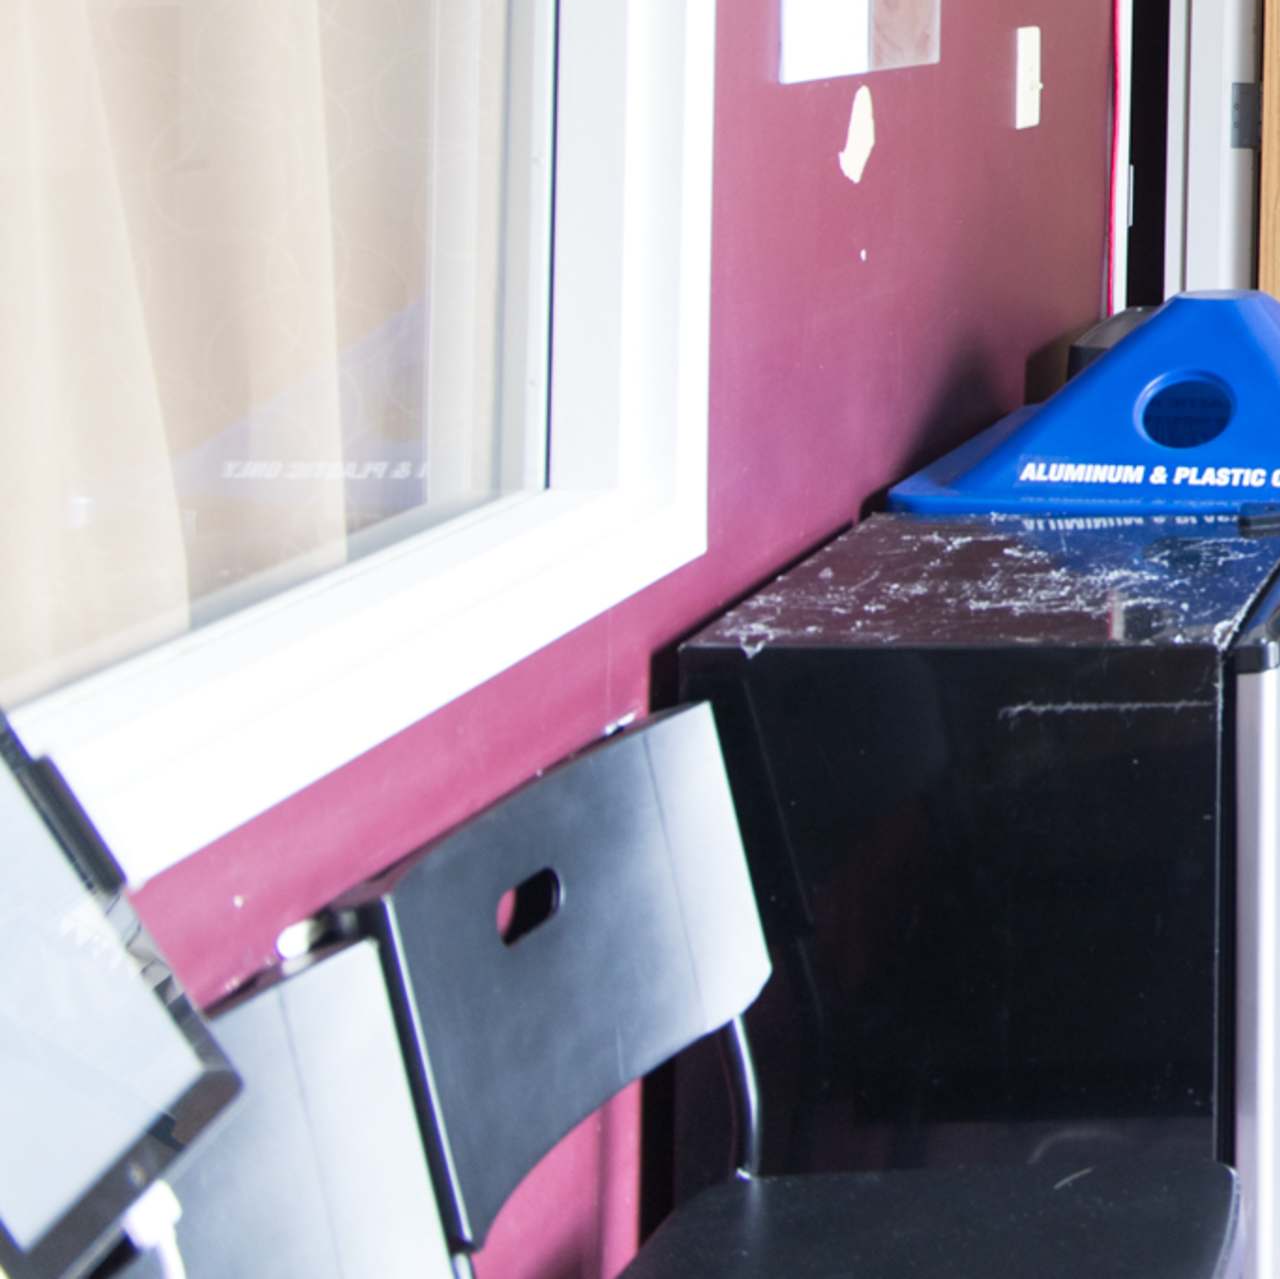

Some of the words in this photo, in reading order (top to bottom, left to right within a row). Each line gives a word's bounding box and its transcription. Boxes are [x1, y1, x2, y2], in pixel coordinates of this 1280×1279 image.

[1019, 462, 1146, 484] ALUMINUM
[1149, 465, 1169, 486] &
[1172, 466, 1267, 488] PLASTIC
